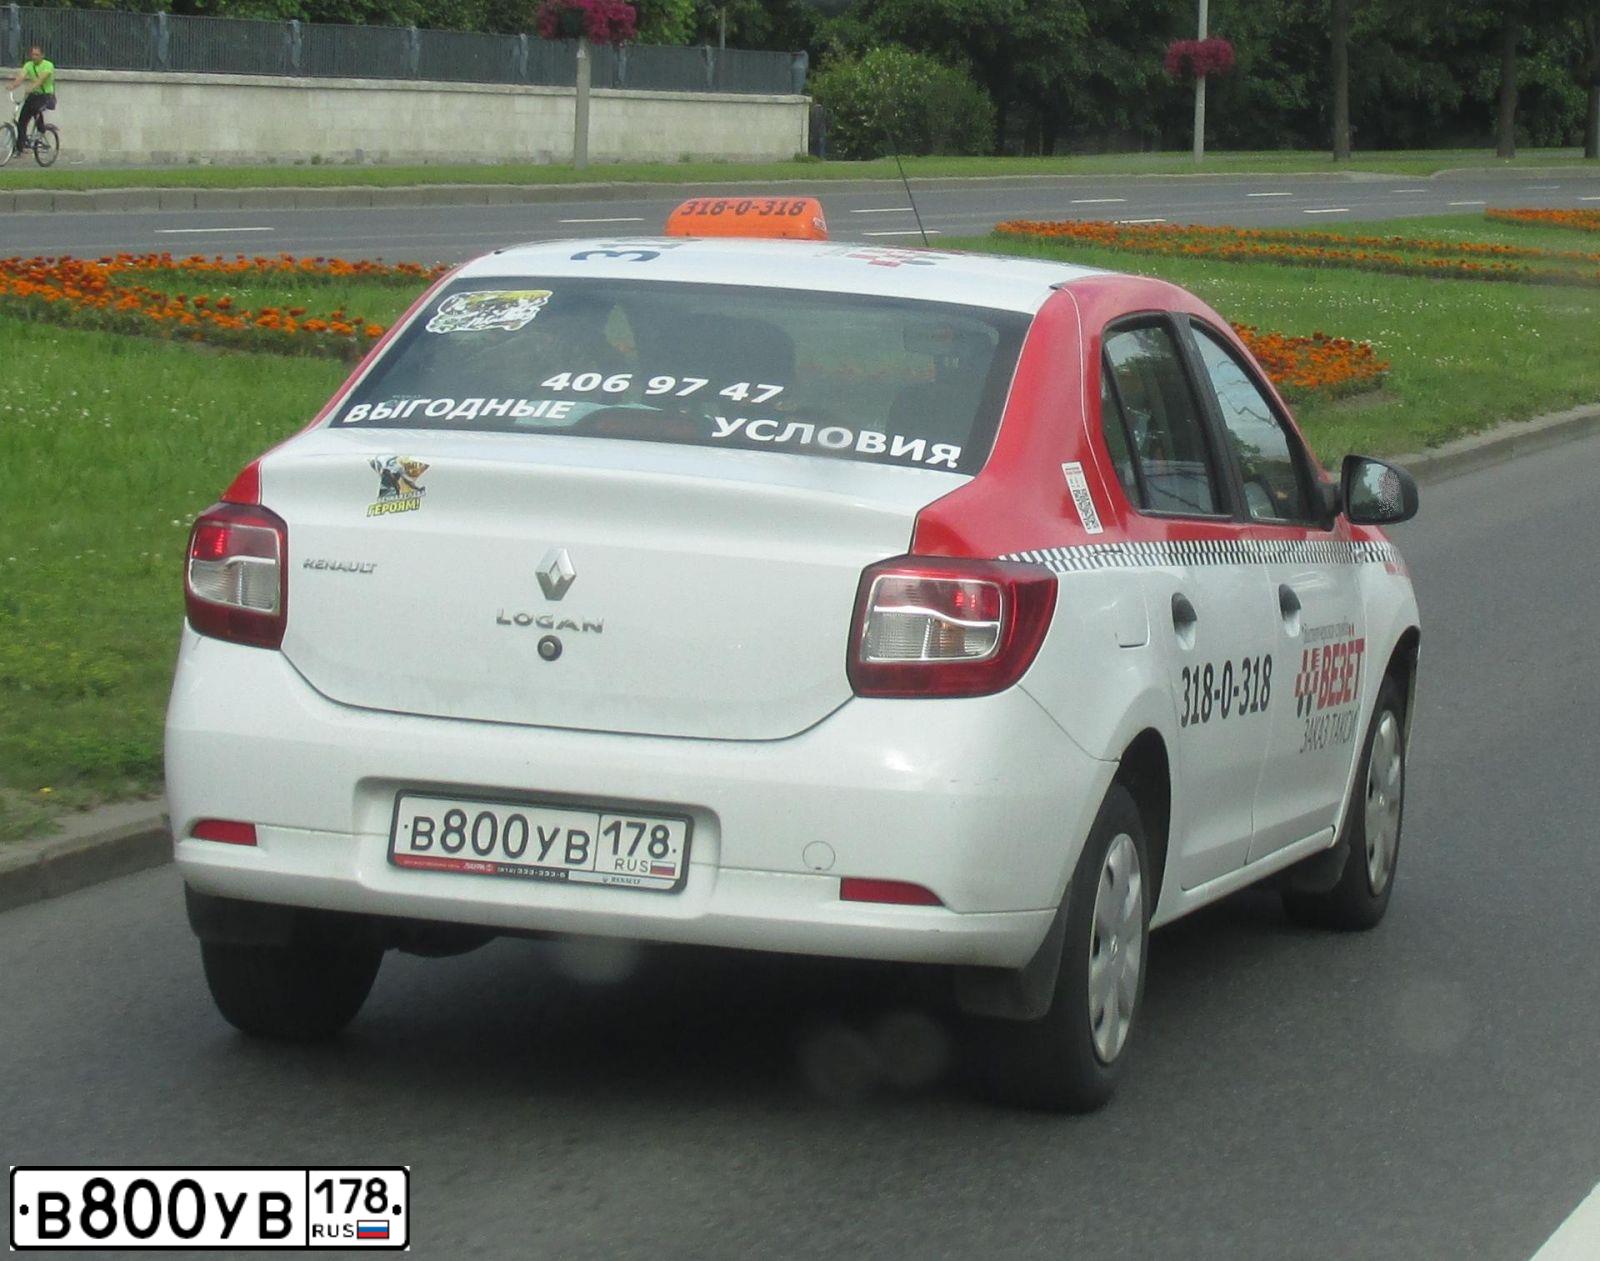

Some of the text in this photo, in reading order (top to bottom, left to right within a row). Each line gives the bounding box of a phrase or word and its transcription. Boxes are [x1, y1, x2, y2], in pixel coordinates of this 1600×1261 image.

[681, 200, 806, 216] 318-0-318
[541, 372, 784, 403] 406 97 47
[343, 397, 576, 424] ВЫГОДНЫЕ
[711, 416, 962, 468] УСЛОВИЯ
[366, 498, 422, 518] ГЕРОЯМ!
[303, 558, 378, 574] RENAULT
[496, 607, 604, 634] LOGAN
[1180, 654, 1273, 728] 318-0-318
[602, 819, 672, 859] 178
[614, 857, 649, 873] RUS
